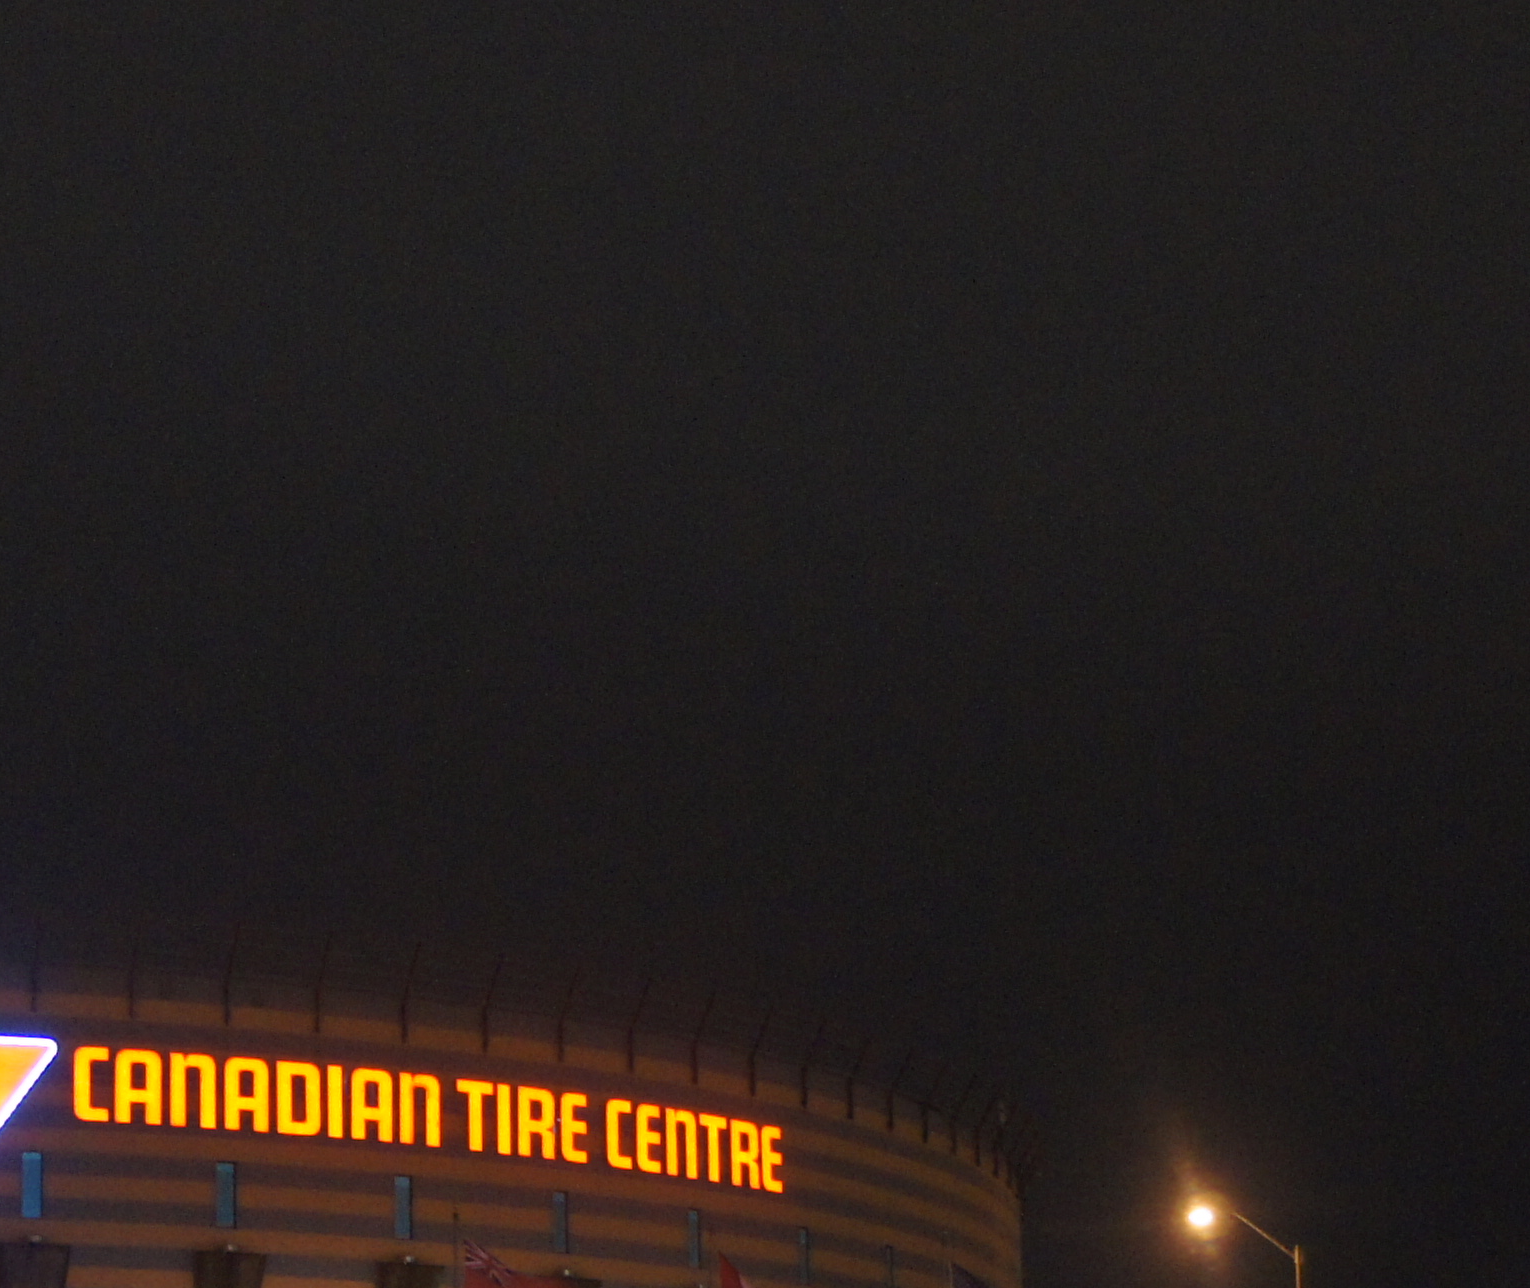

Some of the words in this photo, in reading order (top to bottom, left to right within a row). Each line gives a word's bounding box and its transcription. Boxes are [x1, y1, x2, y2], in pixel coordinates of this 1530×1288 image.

[72, 1044, 443, 1149] CANADIAN
[453, 1078, 590, 1166] TIRE
[604, 1098, 785, 1194] CENTRE
